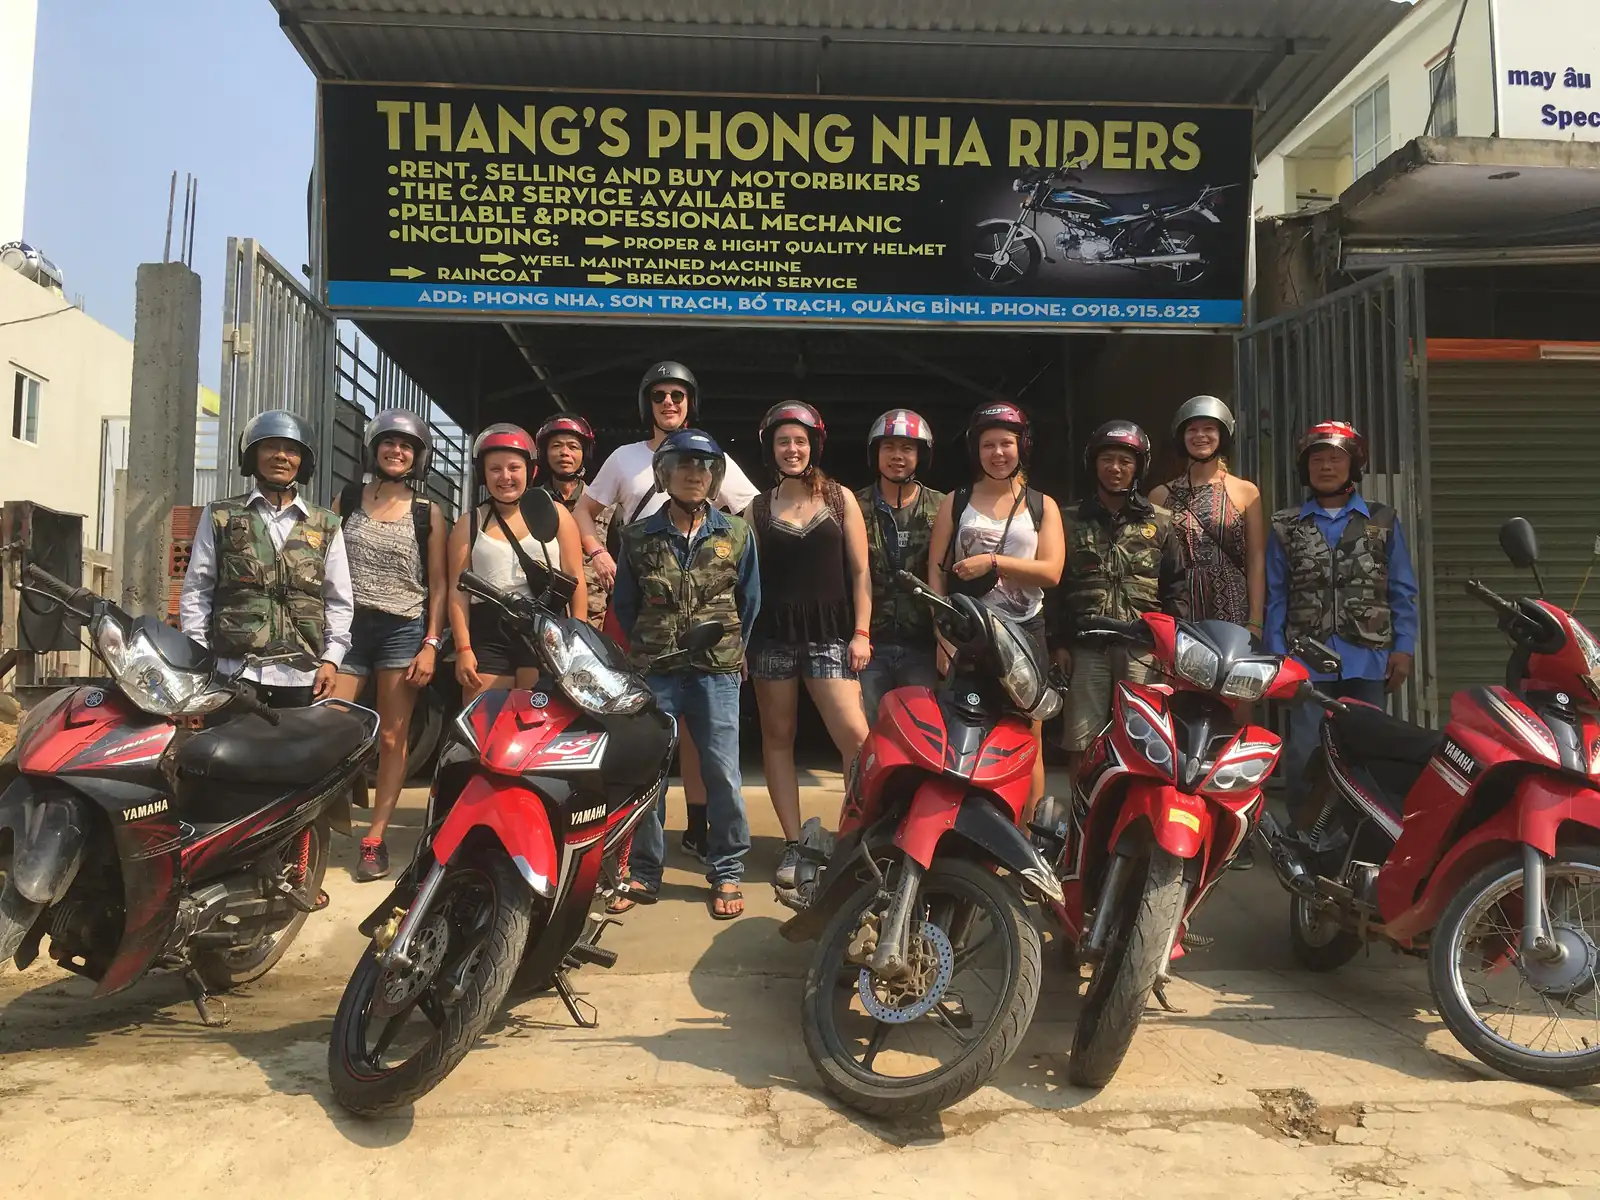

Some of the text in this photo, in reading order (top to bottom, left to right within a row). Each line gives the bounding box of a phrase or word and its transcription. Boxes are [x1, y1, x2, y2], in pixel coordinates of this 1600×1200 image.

[1508, 67, 1592, 90] may âu
[1541, 103, 1600, 130] Spec
[376, 101, 1200, 171] THANG'S PHONG NHA RIDERS
[400, 160, 921, 192] RENT, SELLING AND BUY MOTORBIKERS
[399, 181, 786, 210] THE CAR SERVICE AVAILABLE
[401, 203, 526, 224] PELIABLE
[761, 213, 900, 233] MECHANIC
[401, 224, 559, 247] INCLUDING:
[624, 237, 946, 256] PROPER & HIGHT QUALITY HELMET
[437, 267, 543, 282] RAINCOAT
[521, 255, 799, 273] WEEL MAINTAINED MACHINE
[626, 272, 857, 289] BREAKDOWMN SERVICE
[418, 290, 468, 304] ADD:
[474, 291, 549, 306] PHONG
[554, 293, 605, 309] NHA,
[991, 303, 1066, 317] PHONE:
[1072, 304, 1201, 319] 0918.915.823
[1444, 740, 1475, 774] YAMAHA
[122, 799, 169, 822] YAMAHA
[571, 803, 607, 826] YAMAHA
